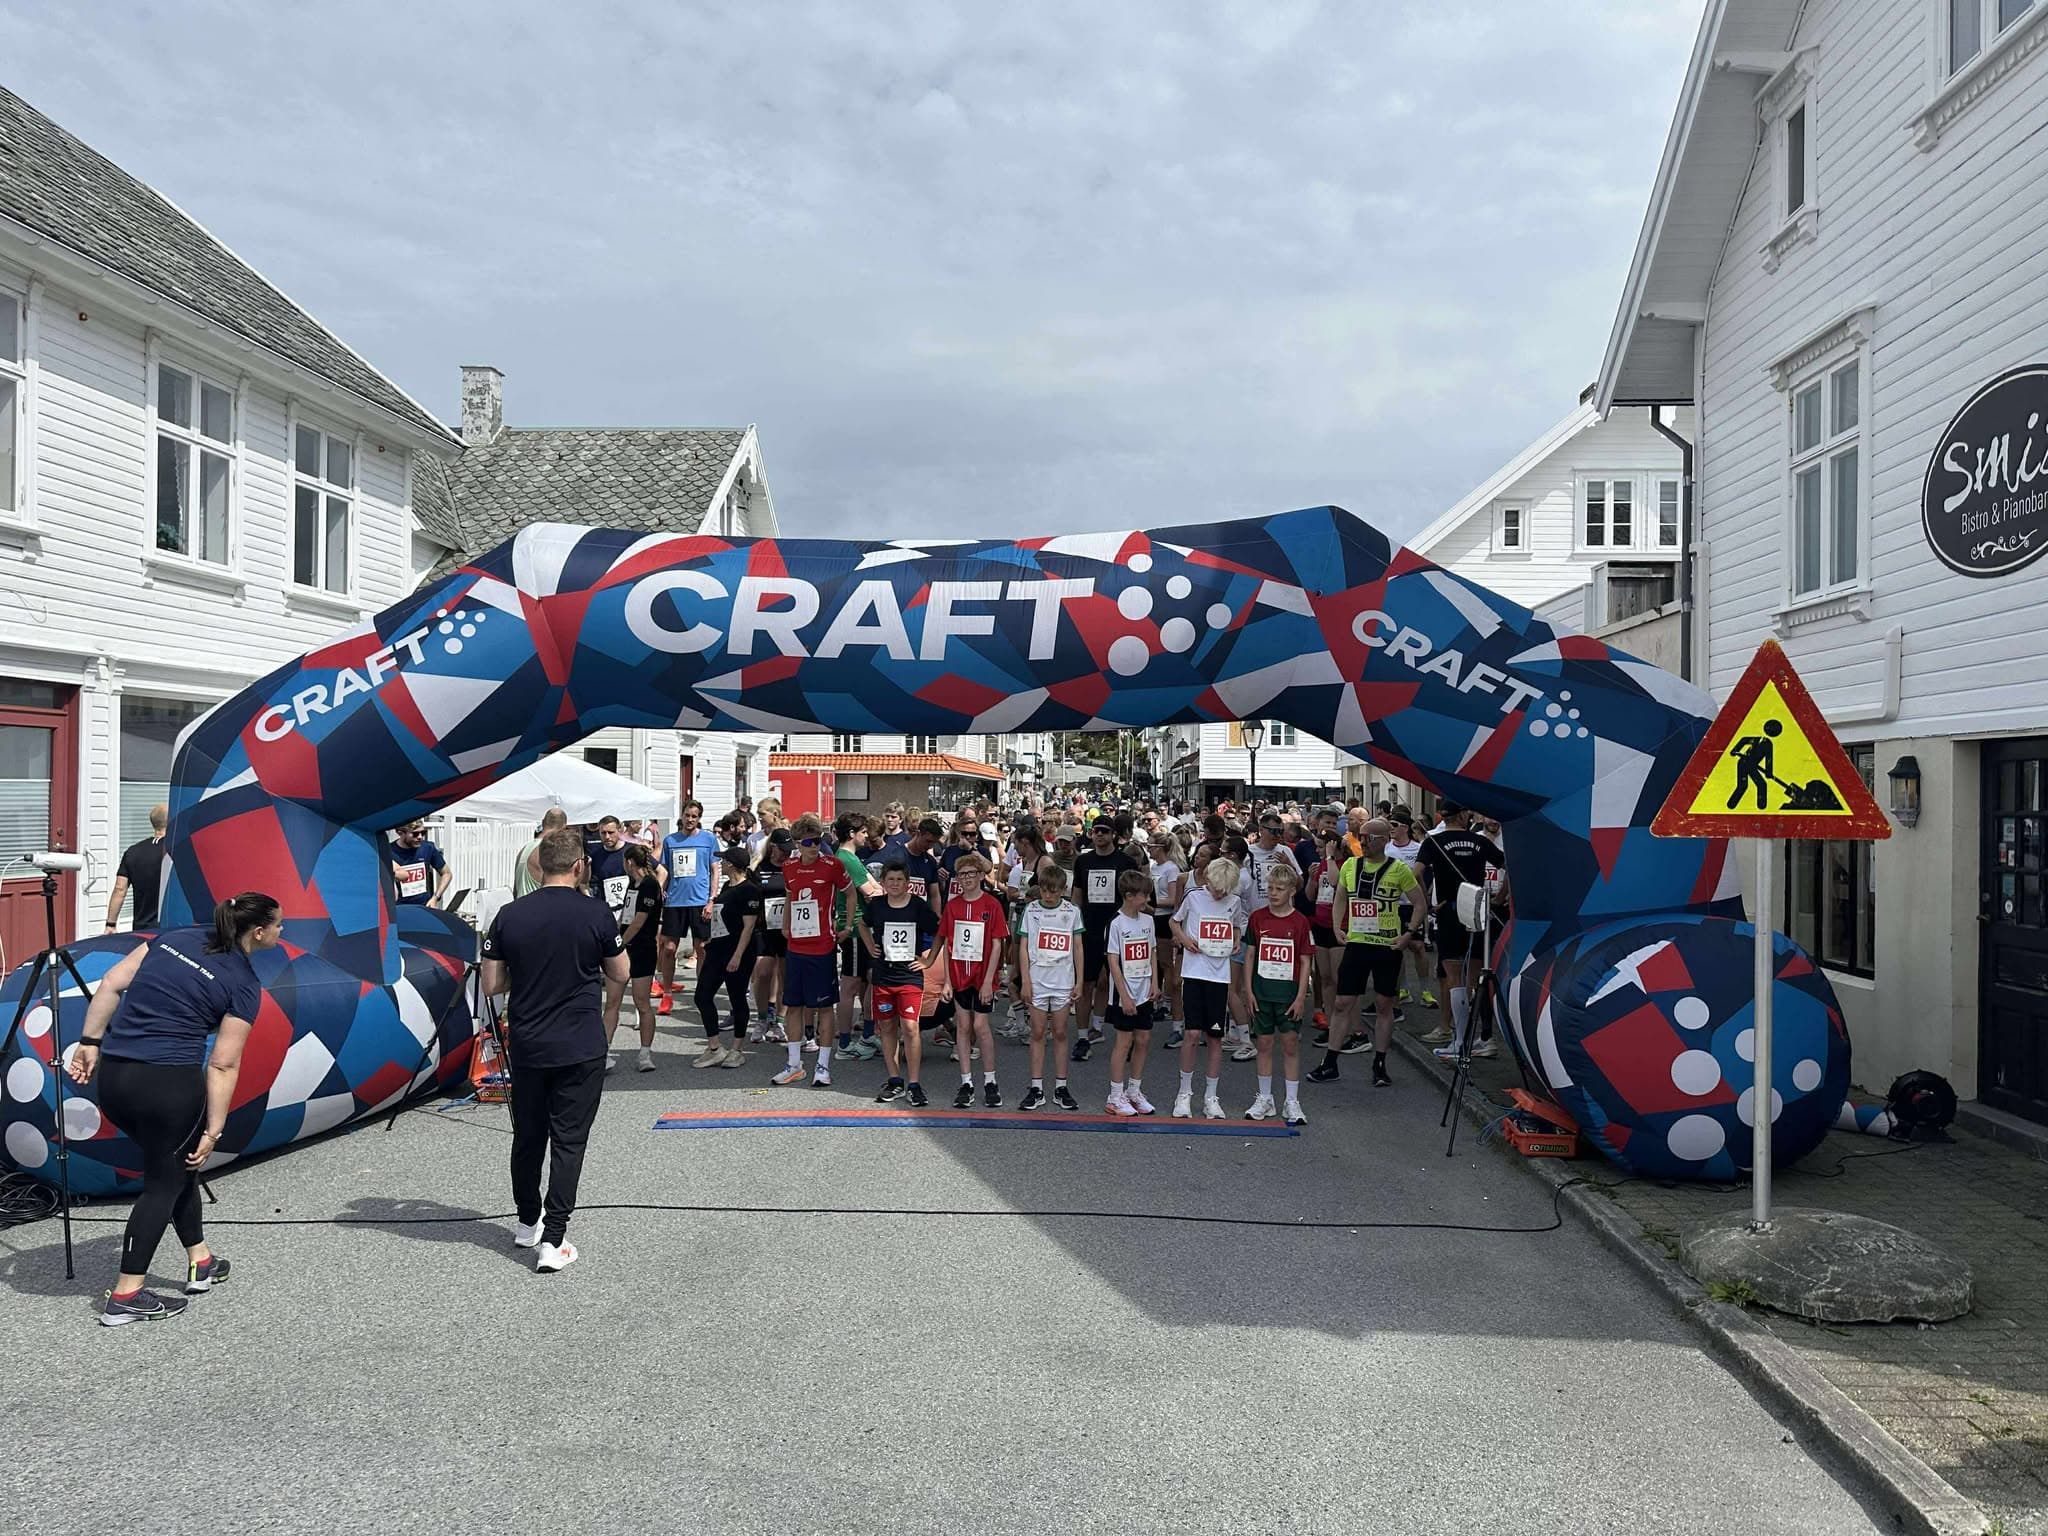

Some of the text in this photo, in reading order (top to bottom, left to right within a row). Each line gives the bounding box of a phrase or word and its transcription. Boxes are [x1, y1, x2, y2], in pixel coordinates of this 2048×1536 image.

[1943, 411, 2048, 513] Smi
[1961, 489, 2048, 535] Bistro & Pianobar
[624, 570, 1096, 661] CRAFT
[1351, 609, 1545, 714] CRAFT
[254, 626, 430, 742] CRAFT
[678, 854, 689, 865] 91
[610, 882, 623, 893] 28
[907, 882, 925, 895] 200
[953, 884, 964, 894] 15
[1095, 875, 1108, 888] 79
[796, 907, 810, 920] 78
[1353, 903, 1375, 917] 188
[891, 930, 908, 943] 32
[963, 928, 971, 943] 9
[1204, 923, 1229, 938] 147
[1043, 934, 1067, 950] 199
[1129, 944, 1147, 960] 181
[1265, 946, 1289, 962] 140
